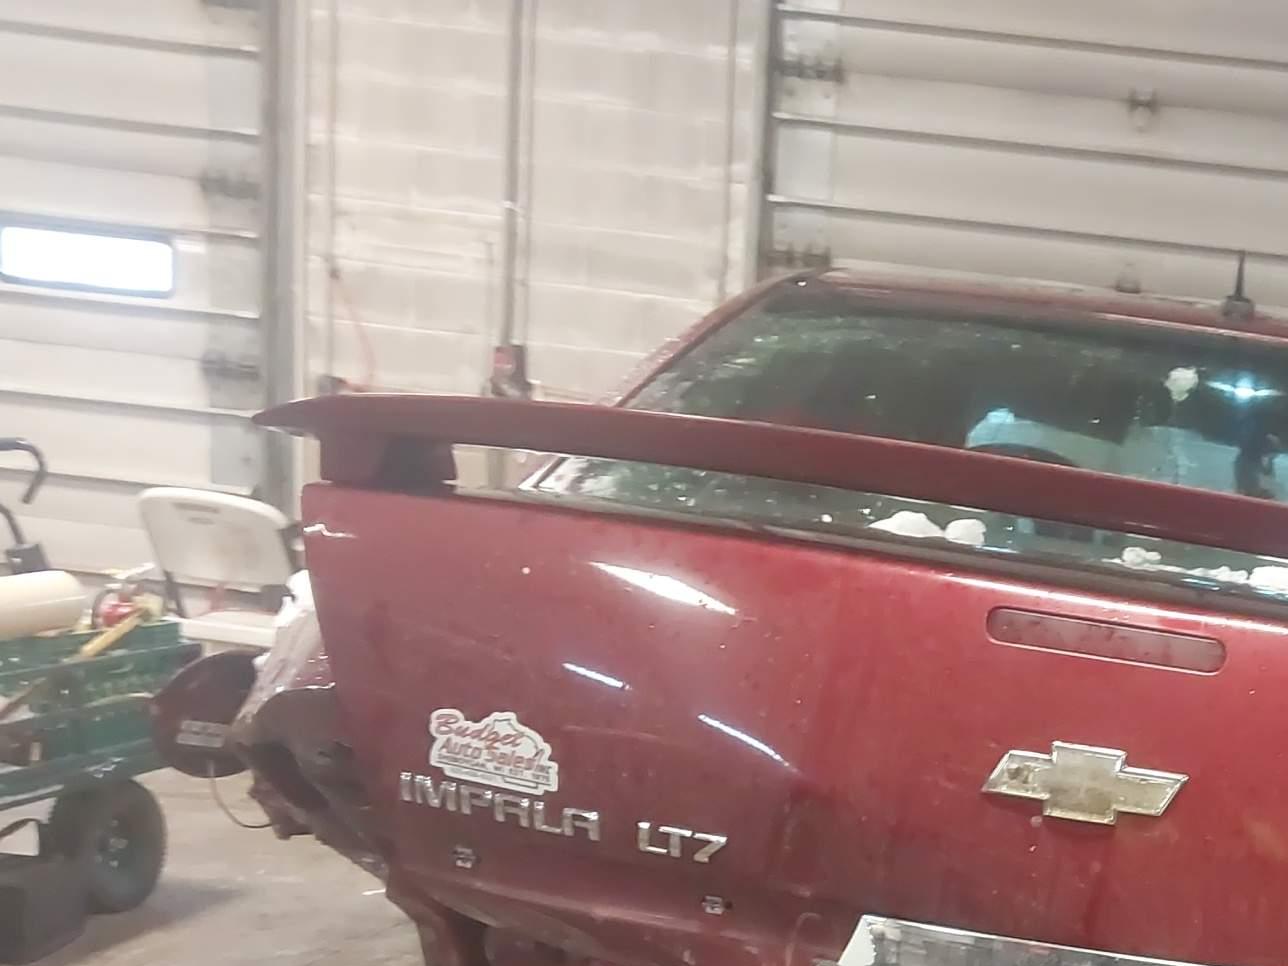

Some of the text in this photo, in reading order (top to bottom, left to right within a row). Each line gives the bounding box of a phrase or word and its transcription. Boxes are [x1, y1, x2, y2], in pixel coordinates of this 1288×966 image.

[435, 713, 524, 753] Budget
[439, 736, 482, 760] Auto
[400, 772, 599, 841] IMPALA
